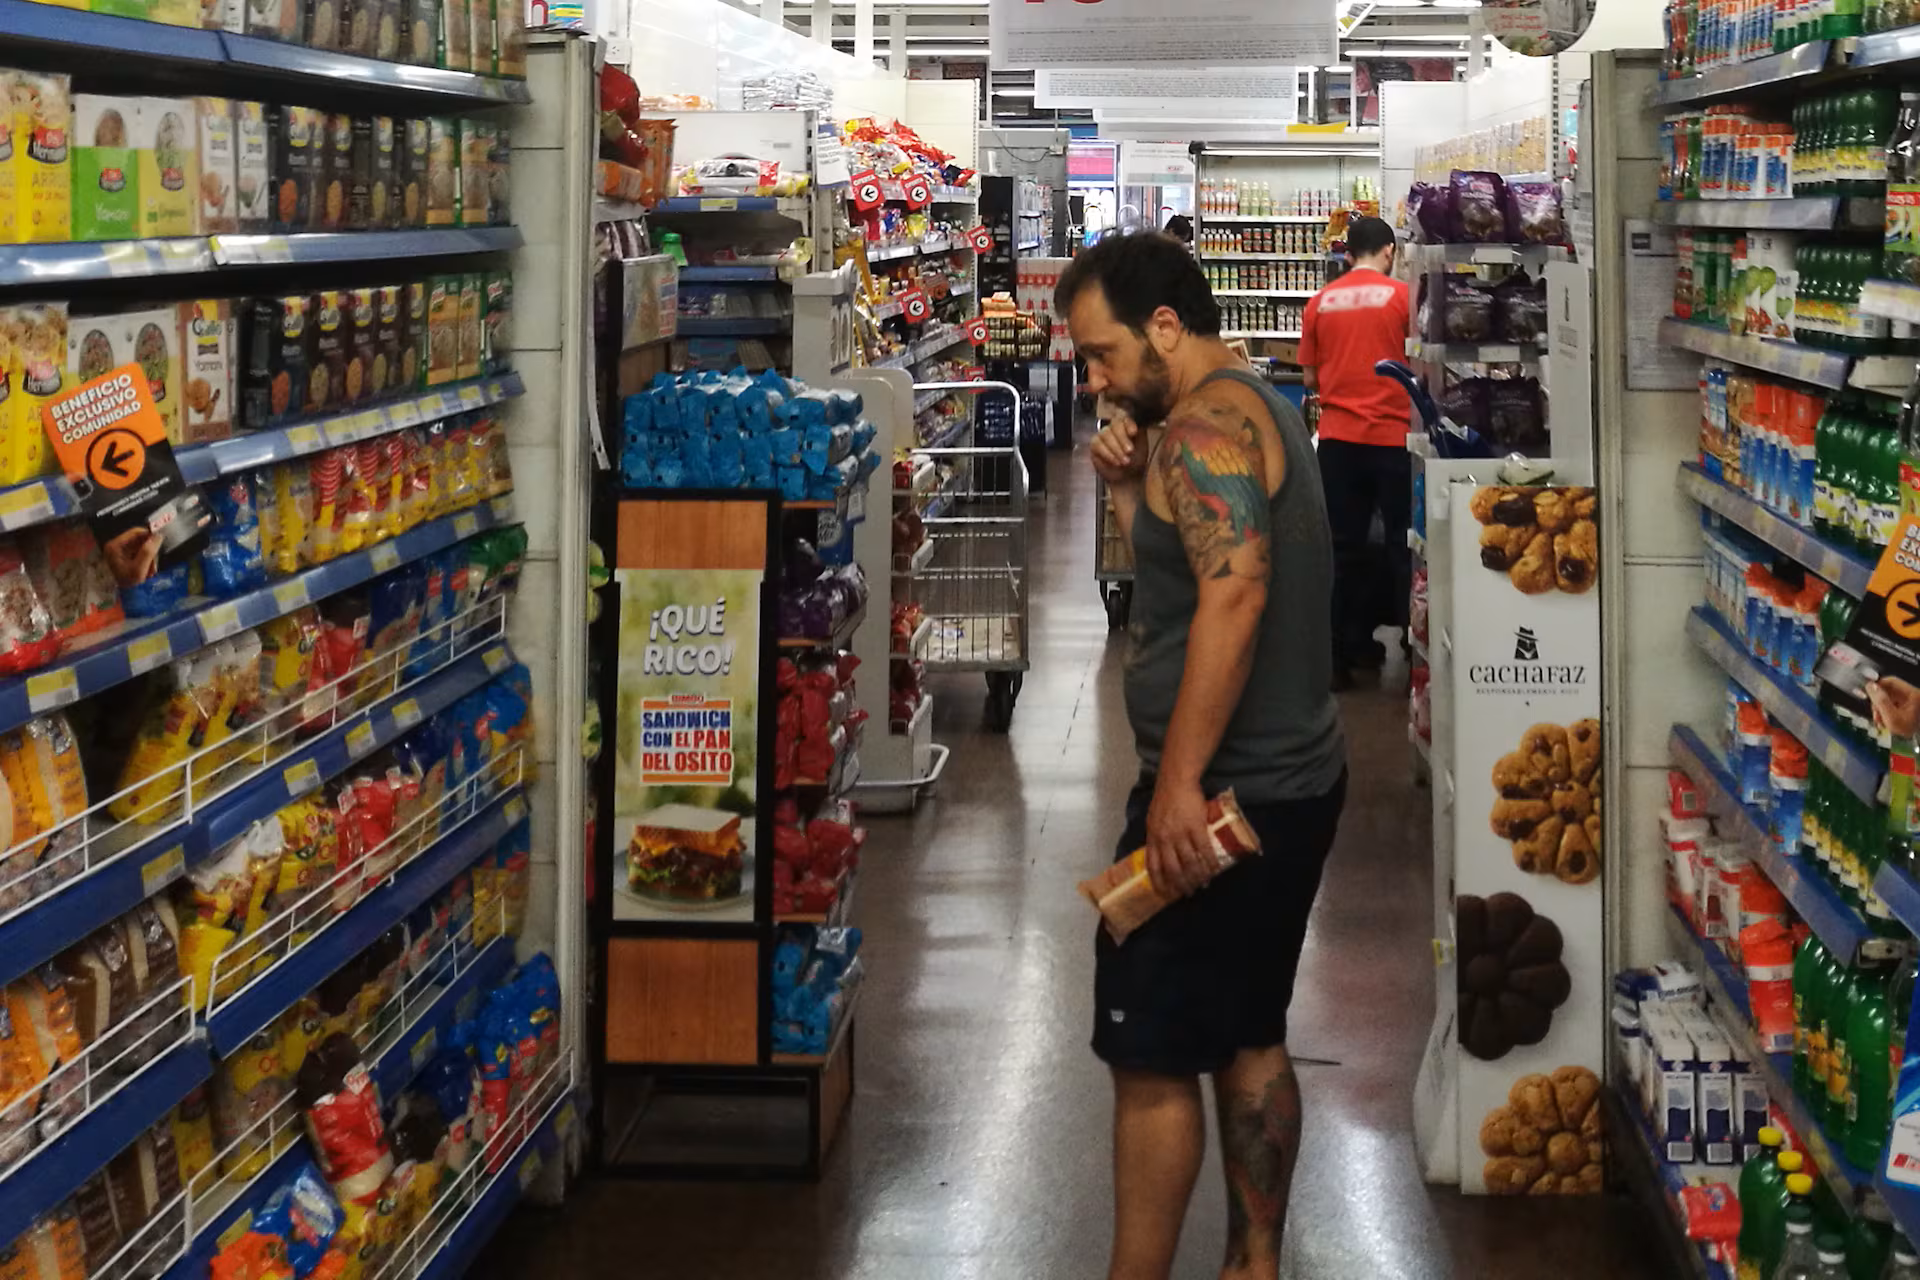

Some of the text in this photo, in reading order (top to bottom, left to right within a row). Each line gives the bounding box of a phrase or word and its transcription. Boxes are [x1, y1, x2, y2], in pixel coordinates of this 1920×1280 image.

[51, 373, 132, 419] BENEFICIO
[57, 387, 137, 433] EXCLUSIVO
[63, 401, 141, 444] COMUNIDAD
[649, 596, 727, 643] ¡QUÉ
[643, 641, 735, 676] RICO!
[642, 710, 731, 729] SANDWICH
[643, 729, 731, 750] CON EL PAN
[642, 750, 732, 773] DEL OSITO
